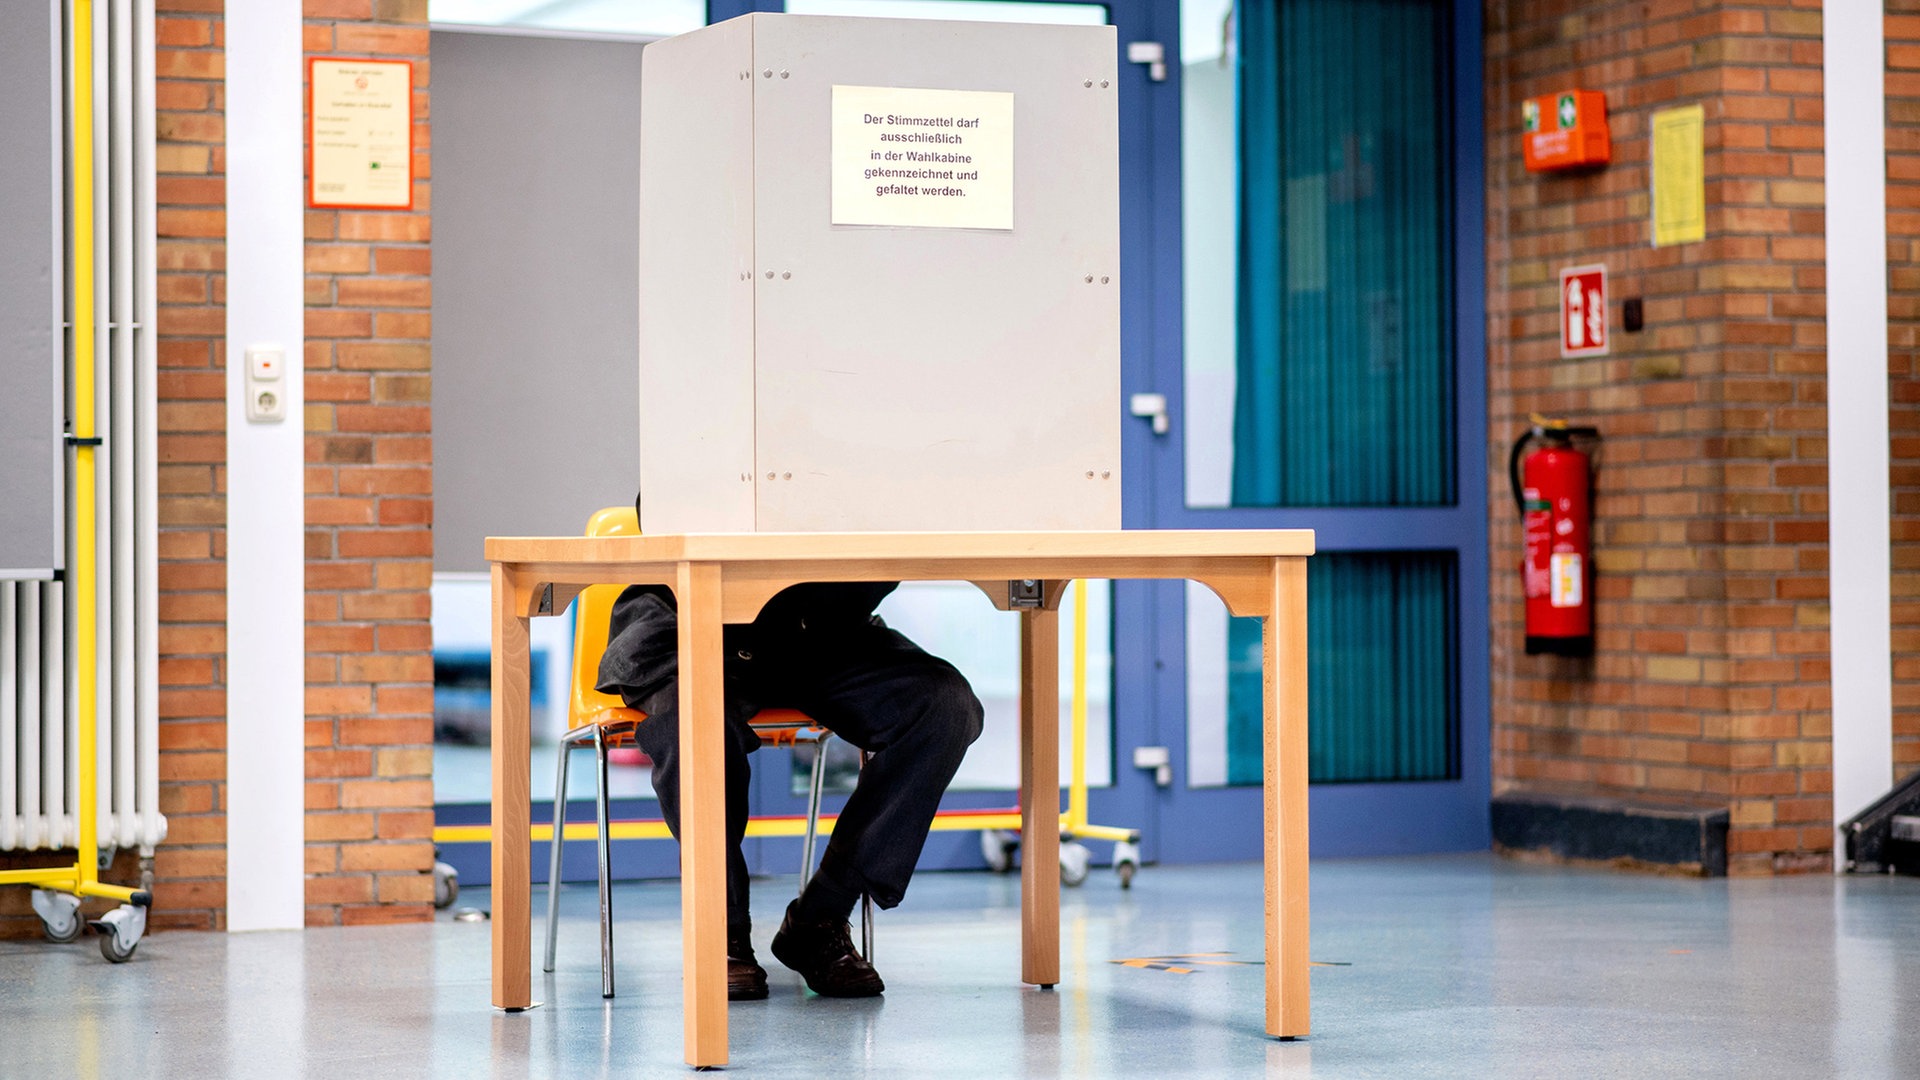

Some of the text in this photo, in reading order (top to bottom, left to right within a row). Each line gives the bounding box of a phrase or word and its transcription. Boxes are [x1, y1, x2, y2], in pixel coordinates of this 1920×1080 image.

[864, 113, 979, 128] Der Stimmzettel darf
[880, 133, 962, 144] ausschließlich
[870, 150, 972, 164] in der Wahlkabine
[864, 167, 978, 180] gekennzeichnet und
[876, 184, 966, 197] gefaltet werden.
